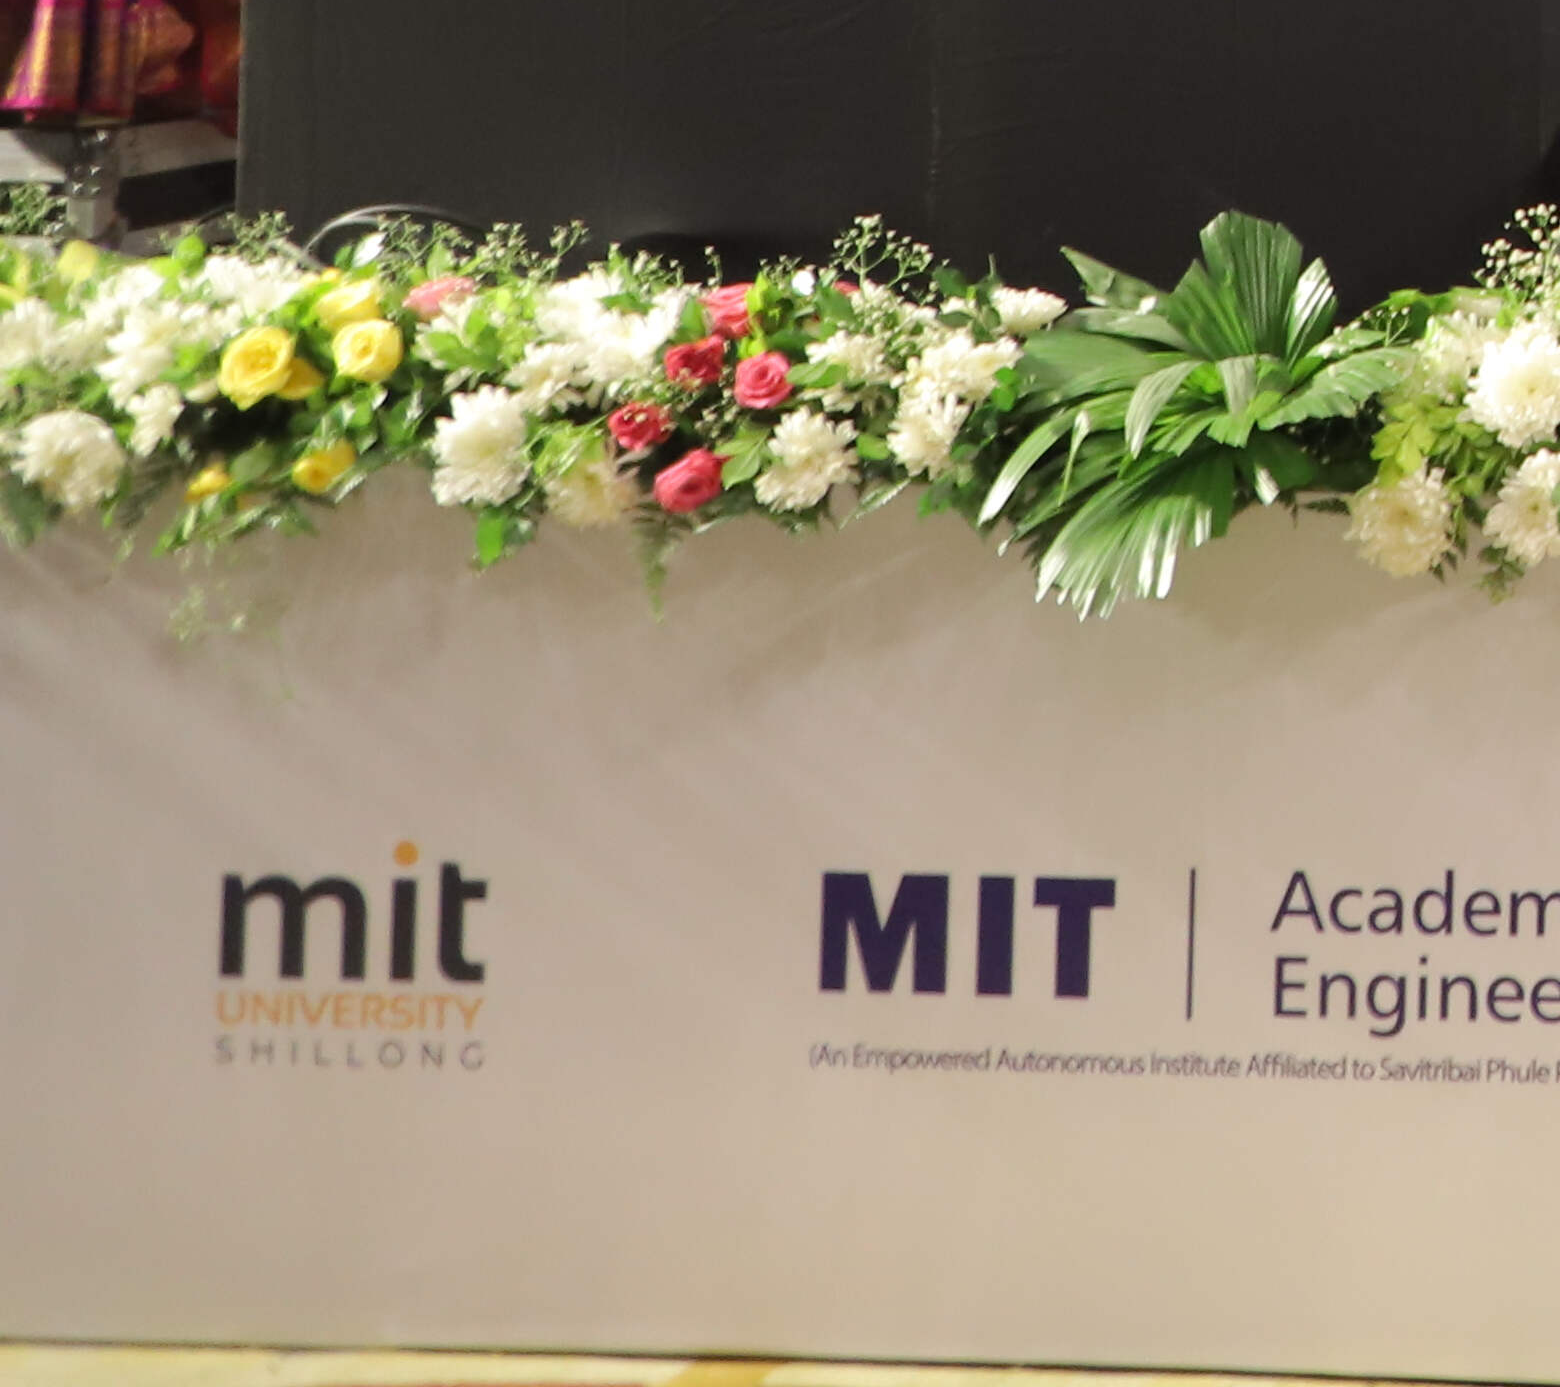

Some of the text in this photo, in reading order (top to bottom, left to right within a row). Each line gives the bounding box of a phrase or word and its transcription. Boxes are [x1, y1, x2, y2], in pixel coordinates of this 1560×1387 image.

[218, 840, 489, 983] mit
[817, 870, 1117, 1000] MIT
[215, 991, 484, 1031] UNIVERSITY
[215, 1036, 486, 1071] SHILLONG
[852, 1044, 990, 1074] Empowered
[997, 1049, 1144, 1076] Autonomous
[1151, 1052, 1240, 1078] Institute
[1246, 1054, 1346, 1080] Affiliated
[1352, 1057, 1374, 1080] to
[1379, 1057, 1481, 1082] Savitribai
[1487, 1058, 1549, 1084] Phule
